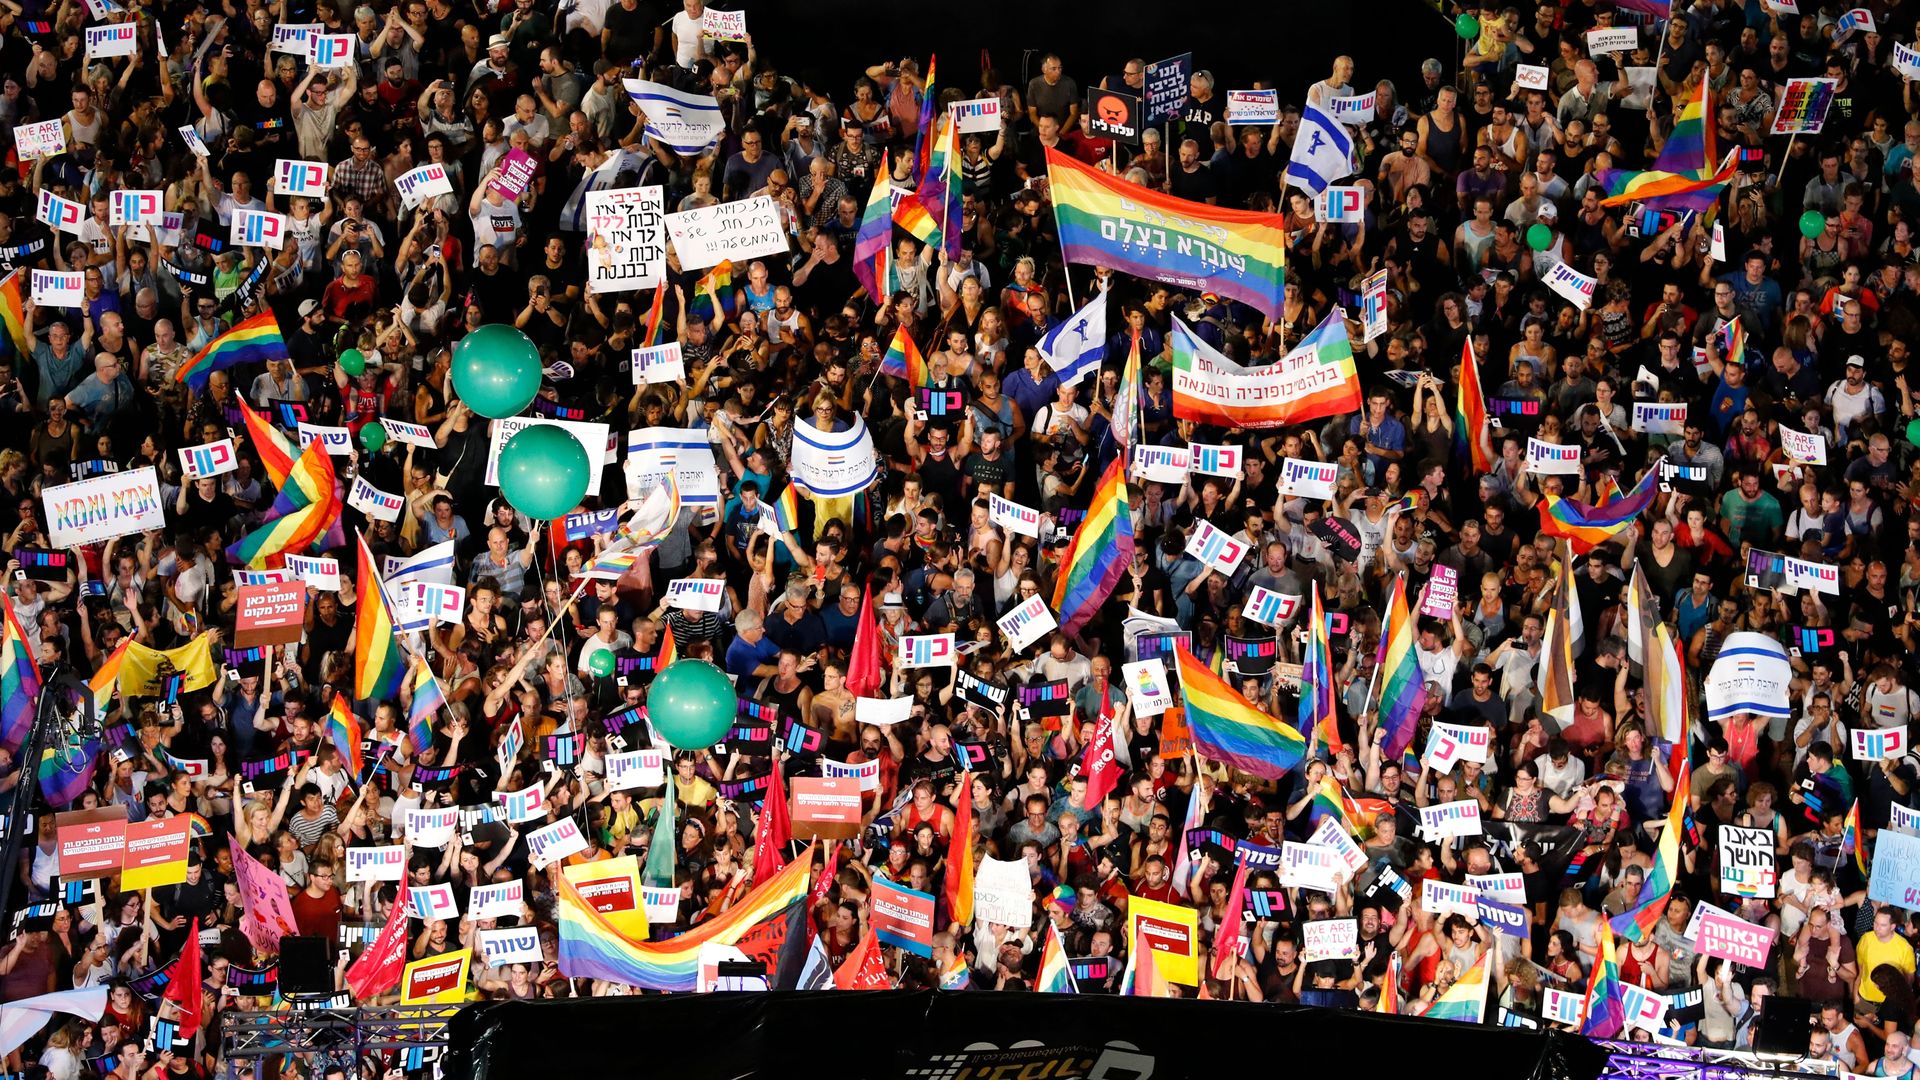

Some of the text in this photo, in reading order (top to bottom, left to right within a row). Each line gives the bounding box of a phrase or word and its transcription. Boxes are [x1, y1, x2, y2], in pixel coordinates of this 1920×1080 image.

[704, 12, 742, 22] WE ARE
[704, 20, 743, 30] FAMILY!
[1159, 64, 1179, 77] תנו
[1150, 73, 1184, 92] לביבי
[1151, 84, 1187, 104] להיות
[16, 122, 59, 137] WE ARE
[1110, 124, 1134, 136] עלה
[19, 131, 61, 148] FAMILY!
[609, 192, 642, 203] ביבי
[640, 200, 660, 211] אם
[592, 213, 662, 228] זכות לילד
[636, 229, 656, 244] לך
[629, 246, 664, 262] זכות
[597, 262, 648, 280] בכנסת
[1794, 435, 1815, 444] ARE
[1325, 516, 1339, 533] BYE
[1338, 528, 1361, 550] BITCH
[246, 593, 298, 607] אנחנו כאן
[244, 604, 298, 618] ובכל מקום
[101, 834, 125, 845] אנחנו
[1724, 826, 1773, 847] באנו
[1725, 846, 1774, 867] חושך
[906, 909, 929, 920] אנחנו
[1479, 902, 1523, 926] שווה
[1306, 922, 1352, 935] WE ARE
[1704, 920, 1758, 948] גאווה
[486, 935, 535, 955] שווה
[1307, 933, 1353, 946] FAMILY!
